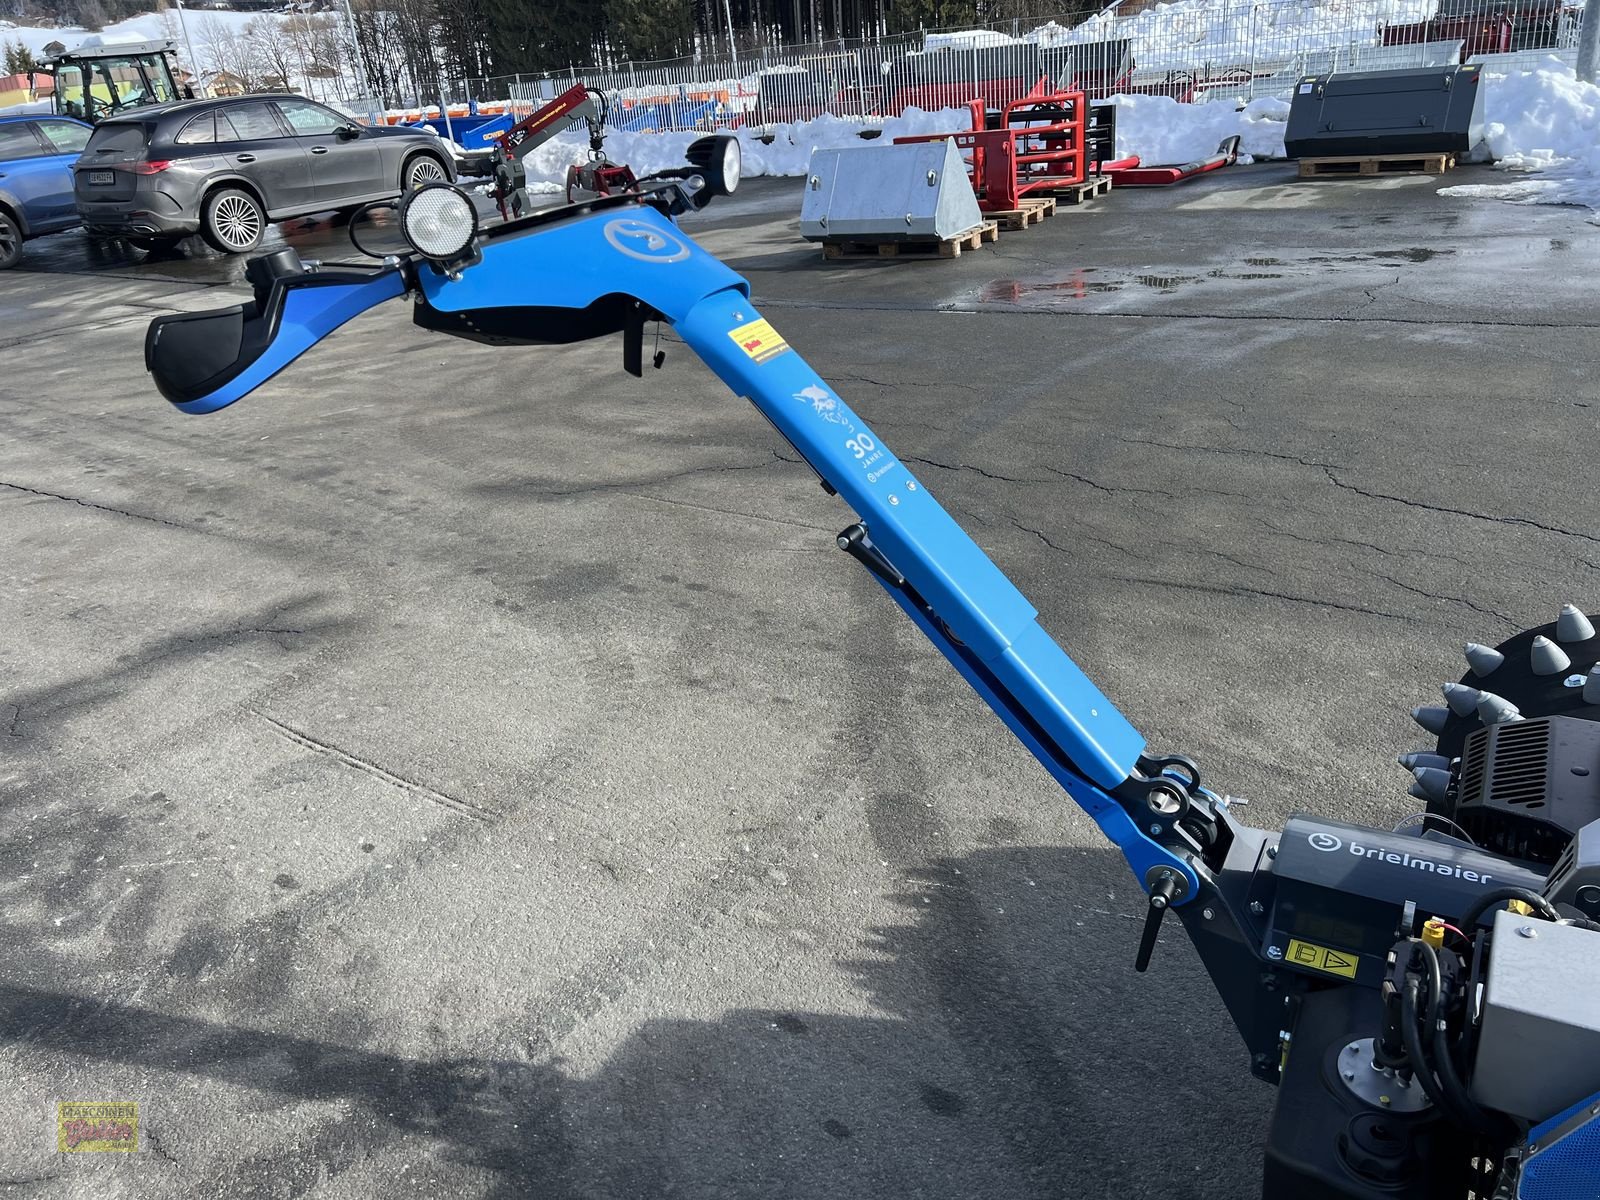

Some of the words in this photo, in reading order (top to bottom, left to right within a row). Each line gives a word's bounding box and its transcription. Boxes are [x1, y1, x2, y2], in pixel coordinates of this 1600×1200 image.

[845, 433, 875, 459] 30
[862, 450, 884, 469] JAHRE
[1350, 841, 1492, 885] brielmaier
